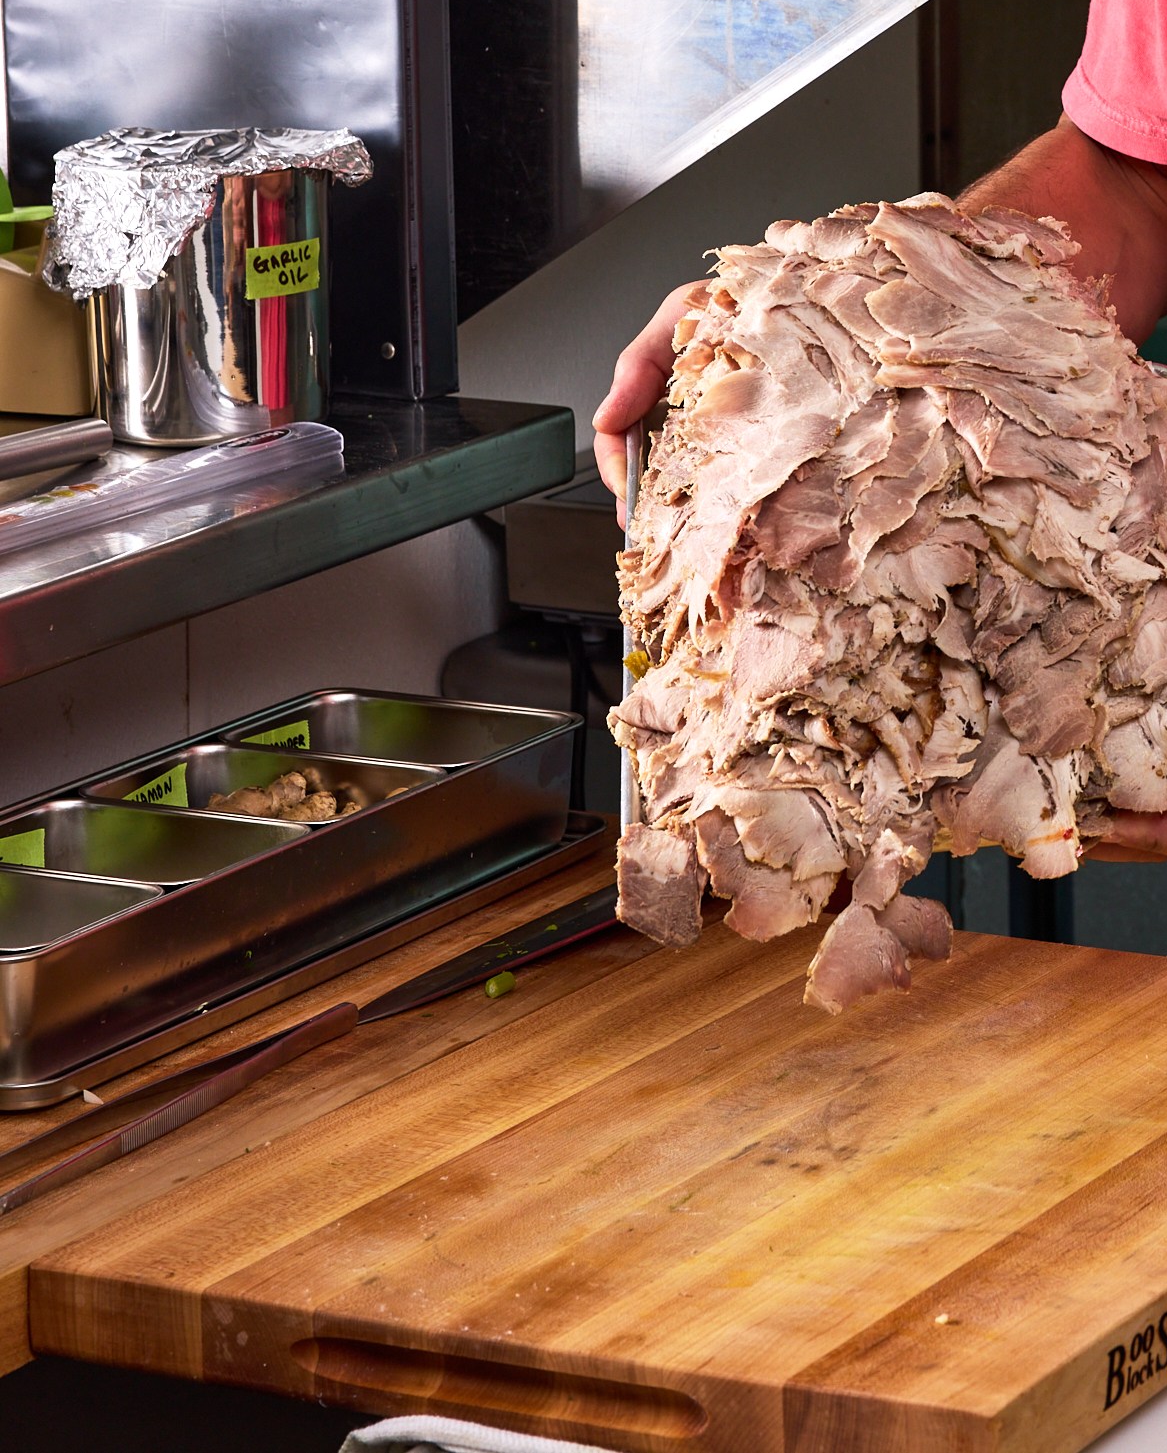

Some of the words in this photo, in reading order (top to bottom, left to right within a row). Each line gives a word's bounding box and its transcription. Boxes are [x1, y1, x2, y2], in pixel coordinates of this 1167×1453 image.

[253, 245, 311, 274] GARLIC
[278, 266, 309, 285] OIL
[270, 733, 306, 748] DER
